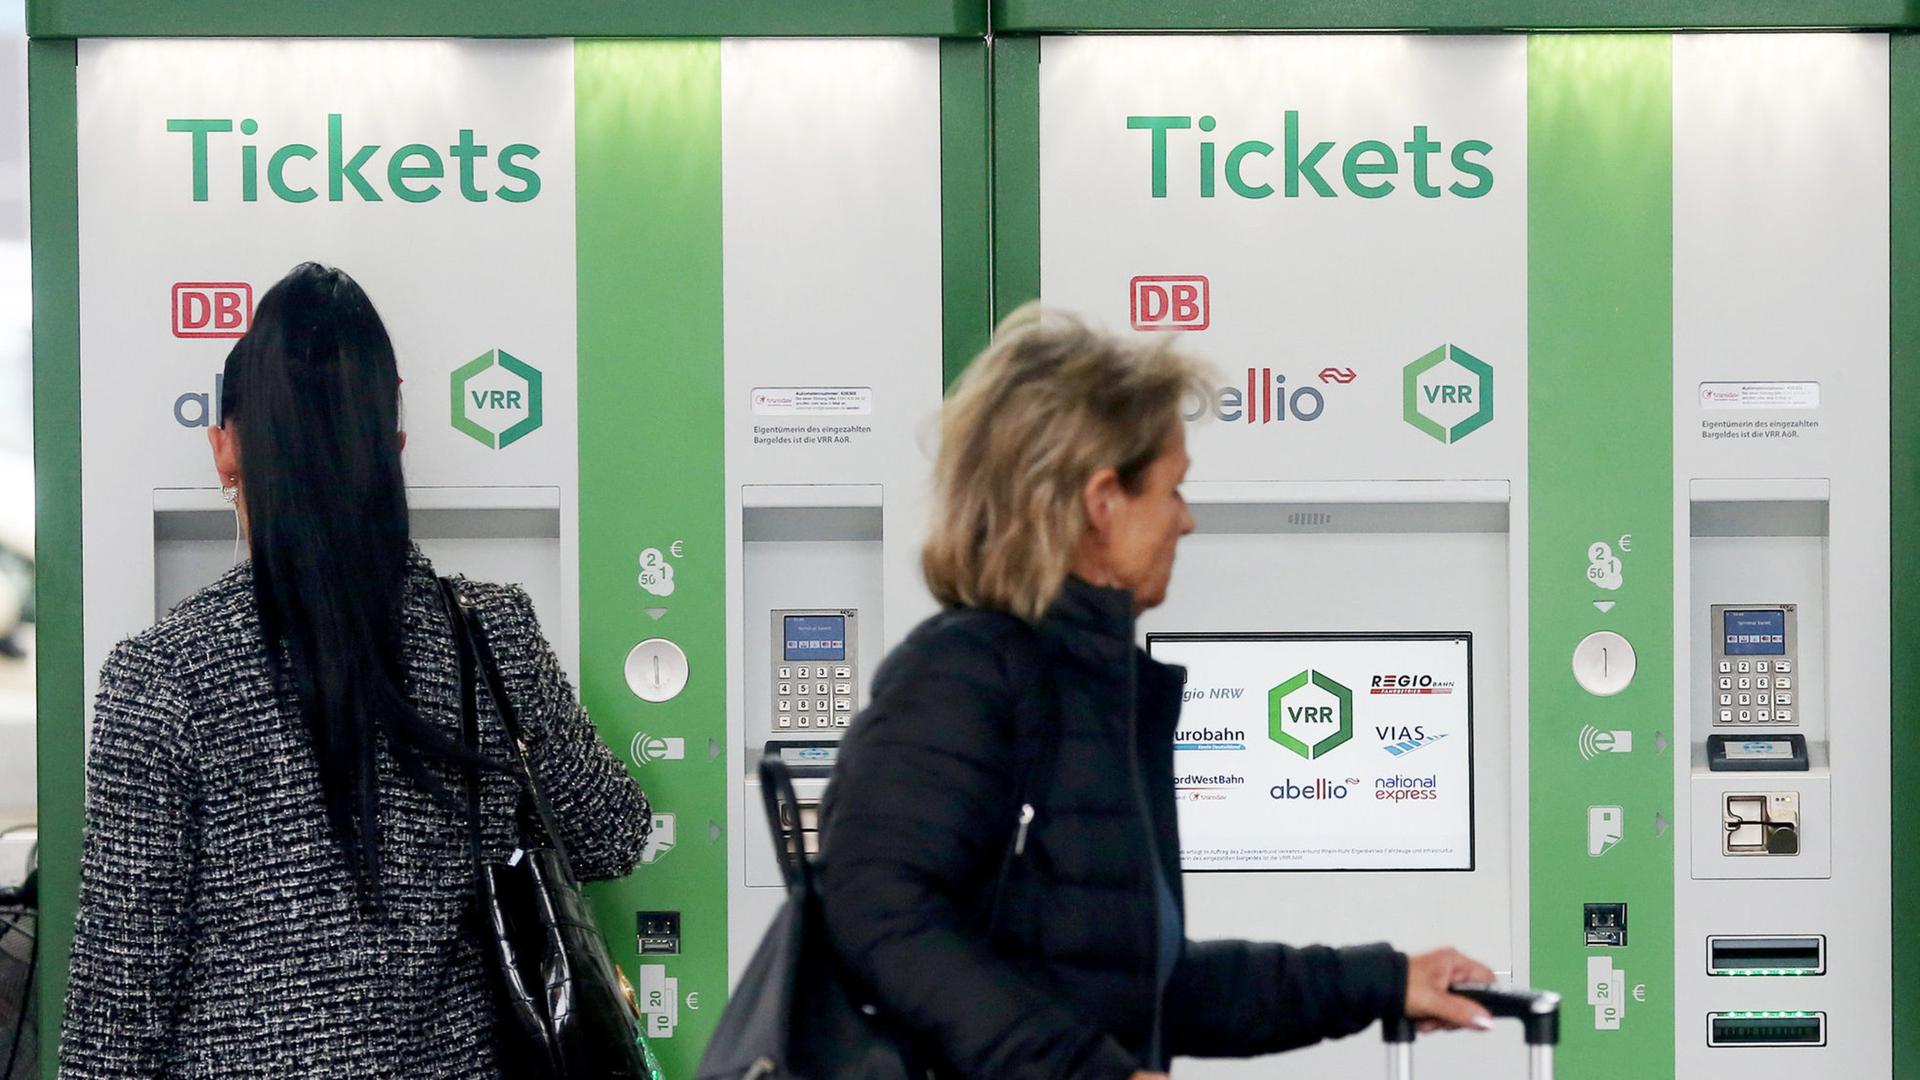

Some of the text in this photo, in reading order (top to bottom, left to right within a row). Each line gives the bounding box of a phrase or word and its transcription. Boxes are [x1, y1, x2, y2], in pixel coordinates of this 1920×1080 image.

[167, 114, 542, 204] Tickets
[1126, 110, 1494, 199] Tickets
[182, 292, 242, 328] DB
[1140, 285, 1199, 322] DB
[471, 390, 521, 409] VRR
[1423, 385, 1473, 404] VRR
[753, 425, 871, 436] Eigentümerin des eingezahlten
[1702, 420, 1819, 430] Eigentümerin des eingezahlten
[753, 436, 791, 446] Bargeldes
[792, 436, 802, 444] ist
[804, 436, 816, 444] die
[1702, 430, 1739, 440] Bargeldes
[1740, 430, 1750, 438] ist
[1751, 430, 1764, 438] die
[647, 553, 656, 567] 2
[1595, 547, 1605, 560] 2
[660, 567, 666, 580] 1
[1589, 567, 1605, 579] 50
[1608, 560, 1615, 573] 1
[641, 573, 656, 585] 50
[1371, 675, 1433, 688] REGIO
[1183, 687, 1245, 703] gio NRW
[1287, 706, 1333, 723] VRR
[1175, 727, 1245, 741] urobahn
[1375, 725, 1425, 741] VIAS
[1173, 774, 1245, 785] ordWestBahn
[1375, 774, 1436, 789] national
[1270, 778, 1348, 800] abellio
[1375, 789, 1437, 804] express
[1597, 982, 1609, 999] 20
[650, 990, 662, 1007] 20
[1604, 1007, 1616, 1023] 10
[657, 1015, 669, 1031] 10
